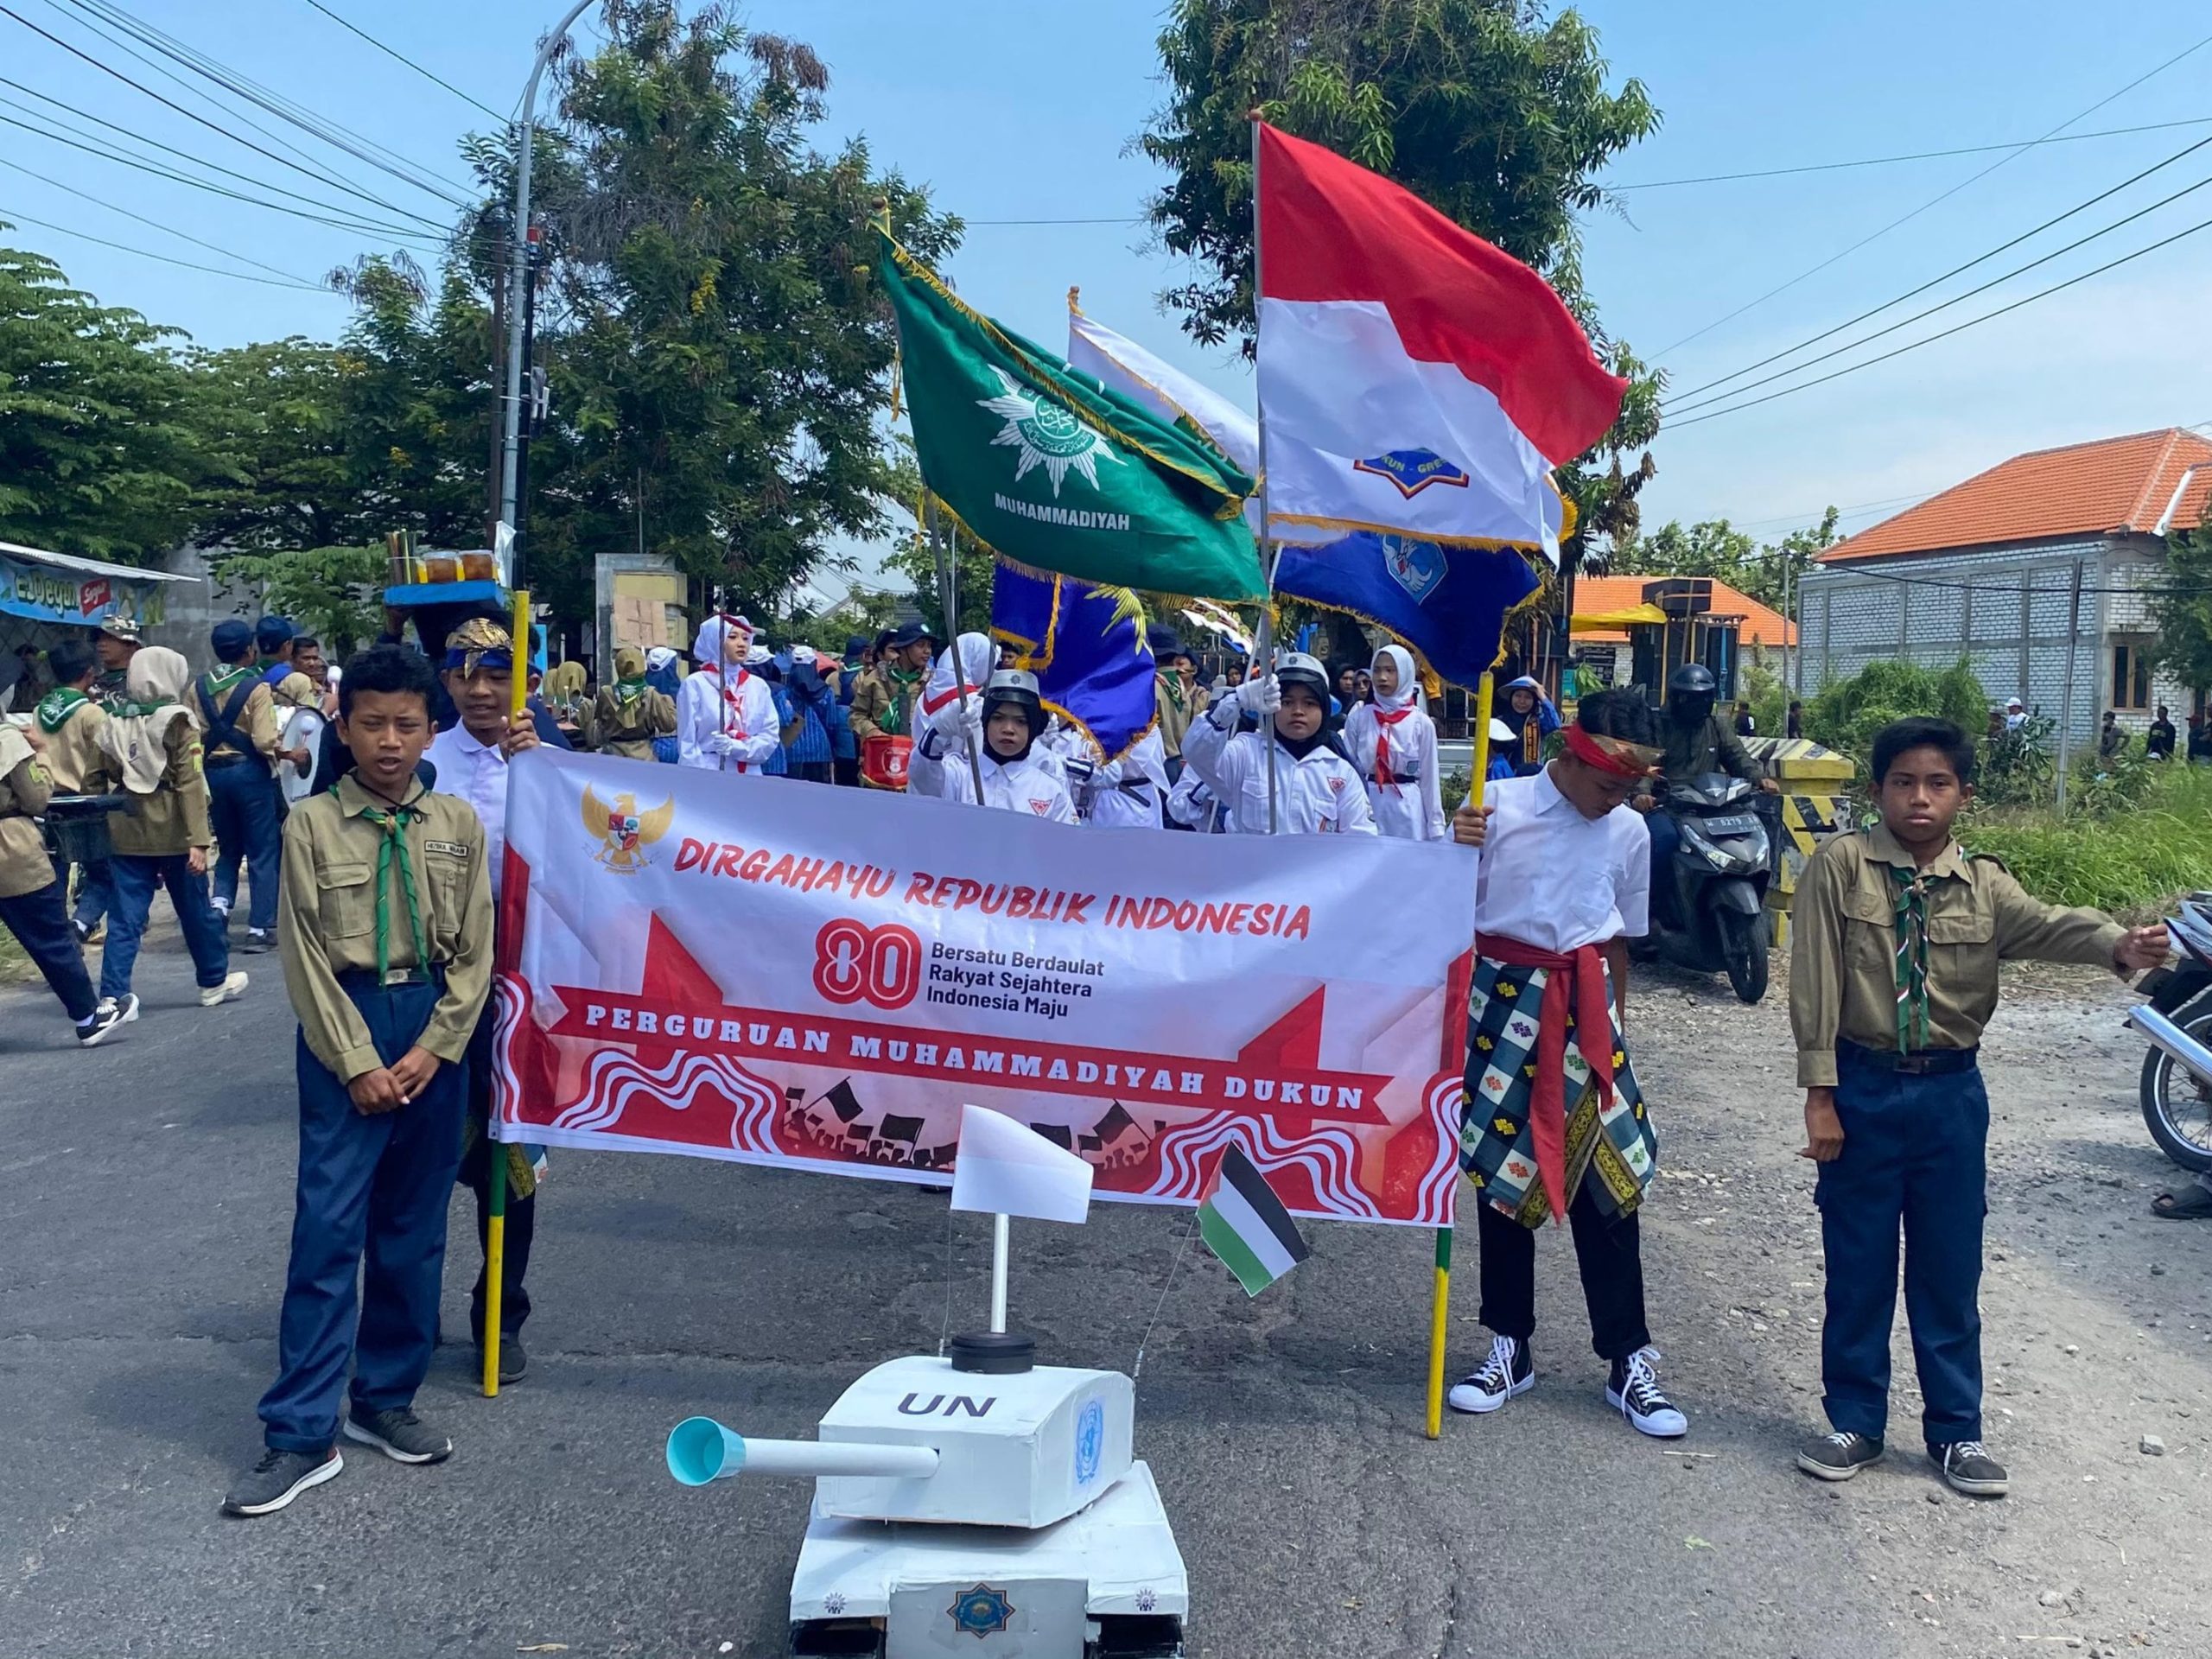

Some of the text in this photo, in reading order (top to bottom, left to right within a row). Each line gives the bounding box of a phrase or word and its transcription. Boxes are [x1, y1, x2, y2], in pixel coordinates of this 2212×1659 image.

[995, 493, 1129, 531] MUHAMMADIYAH
[674, 838, 1310, 941] DIRGAHAYU REPUBLIK INDONESIA
[813, 918, 922, 1010] 80
[931, 943, 1104, 976] Bersatu Berdaulat
[929, 964, 1092, 997] Rakyat Sejahtera
[927, 986, 1068, 1020] Indonesia Maju
[586, 1004, 1363, 1109] PERGURUAN MUHAMMADIYAH DUKUN
[897, 1392, 997, 1417] UN
